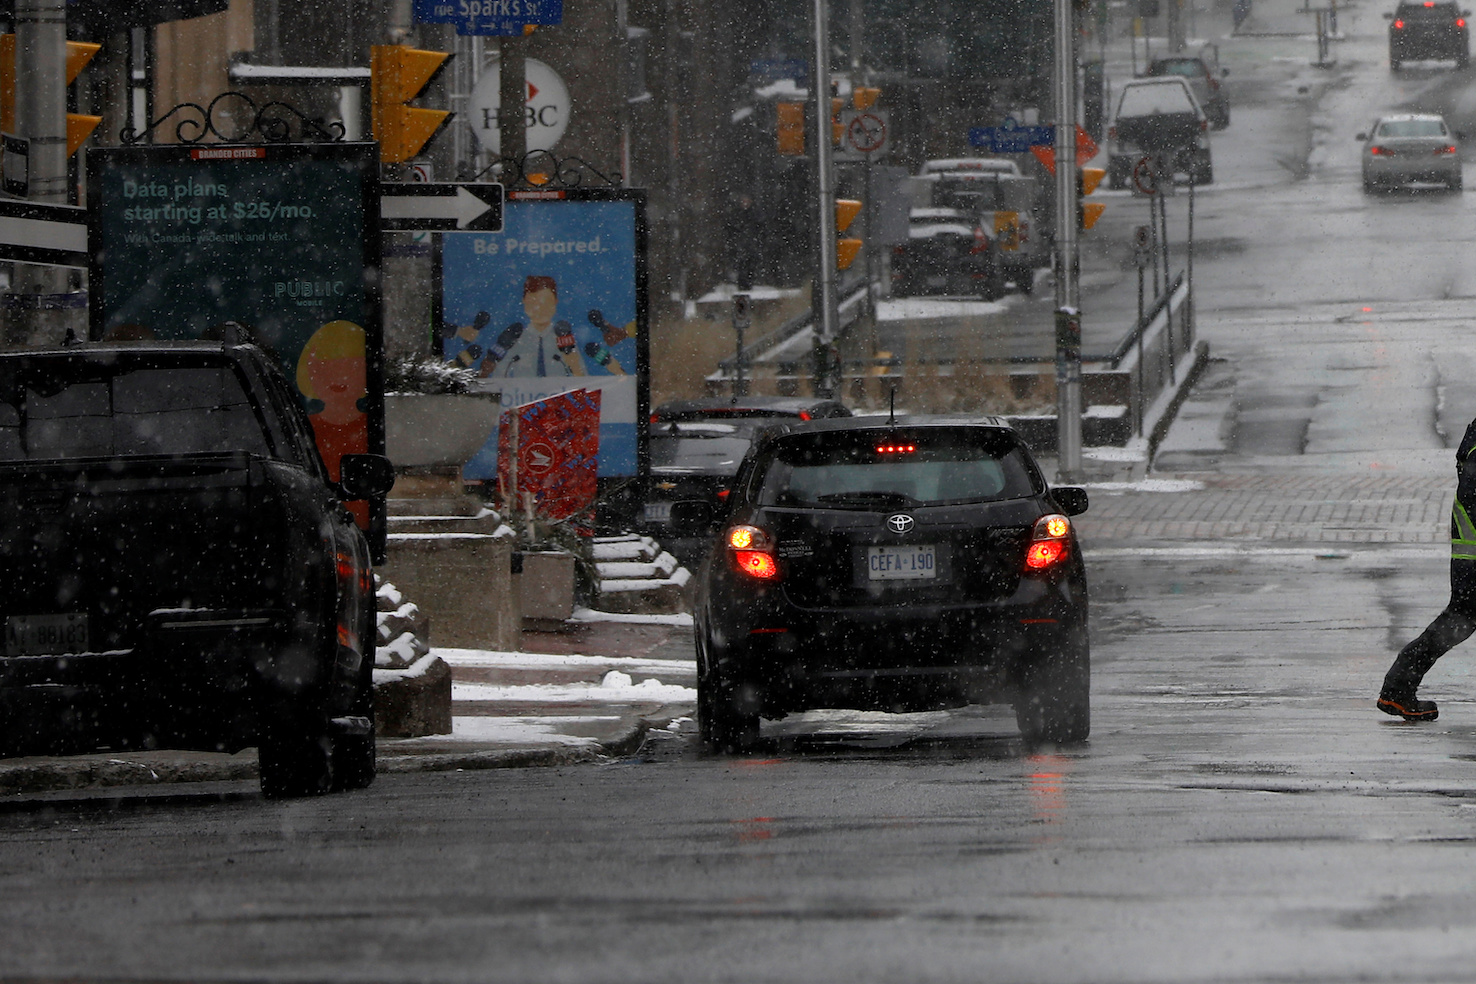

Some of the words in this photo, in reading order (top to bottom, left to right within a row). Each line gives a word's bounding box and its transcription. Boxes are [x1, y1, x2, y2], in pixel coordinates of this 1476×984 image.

[434, 5, 453, 16] rue
[481, 105, 558, 129] HBC
[199, 149, 231, 159] BRANDED
[233, 148, 257, 158] CITIES
[123, 180, 168, 198] Data
[174, 179, 227, 201] plans
[124, 202, 201, 224] starting
[207, 203, 227, 220] at
[233, 201, 317, 222] $25/mo.
[124, 233, 148, 243] With
[224, 232, 244, 242] talk
[245, 232, 266, 242] and
[474, 238, 499, 255] Be
[506, 236, 603, 258] Prepared.
[274, 281, 344, 298] PUBLIC
[871, 554, 902, 571] CEFA
[911, 553, 933, 570] 190
